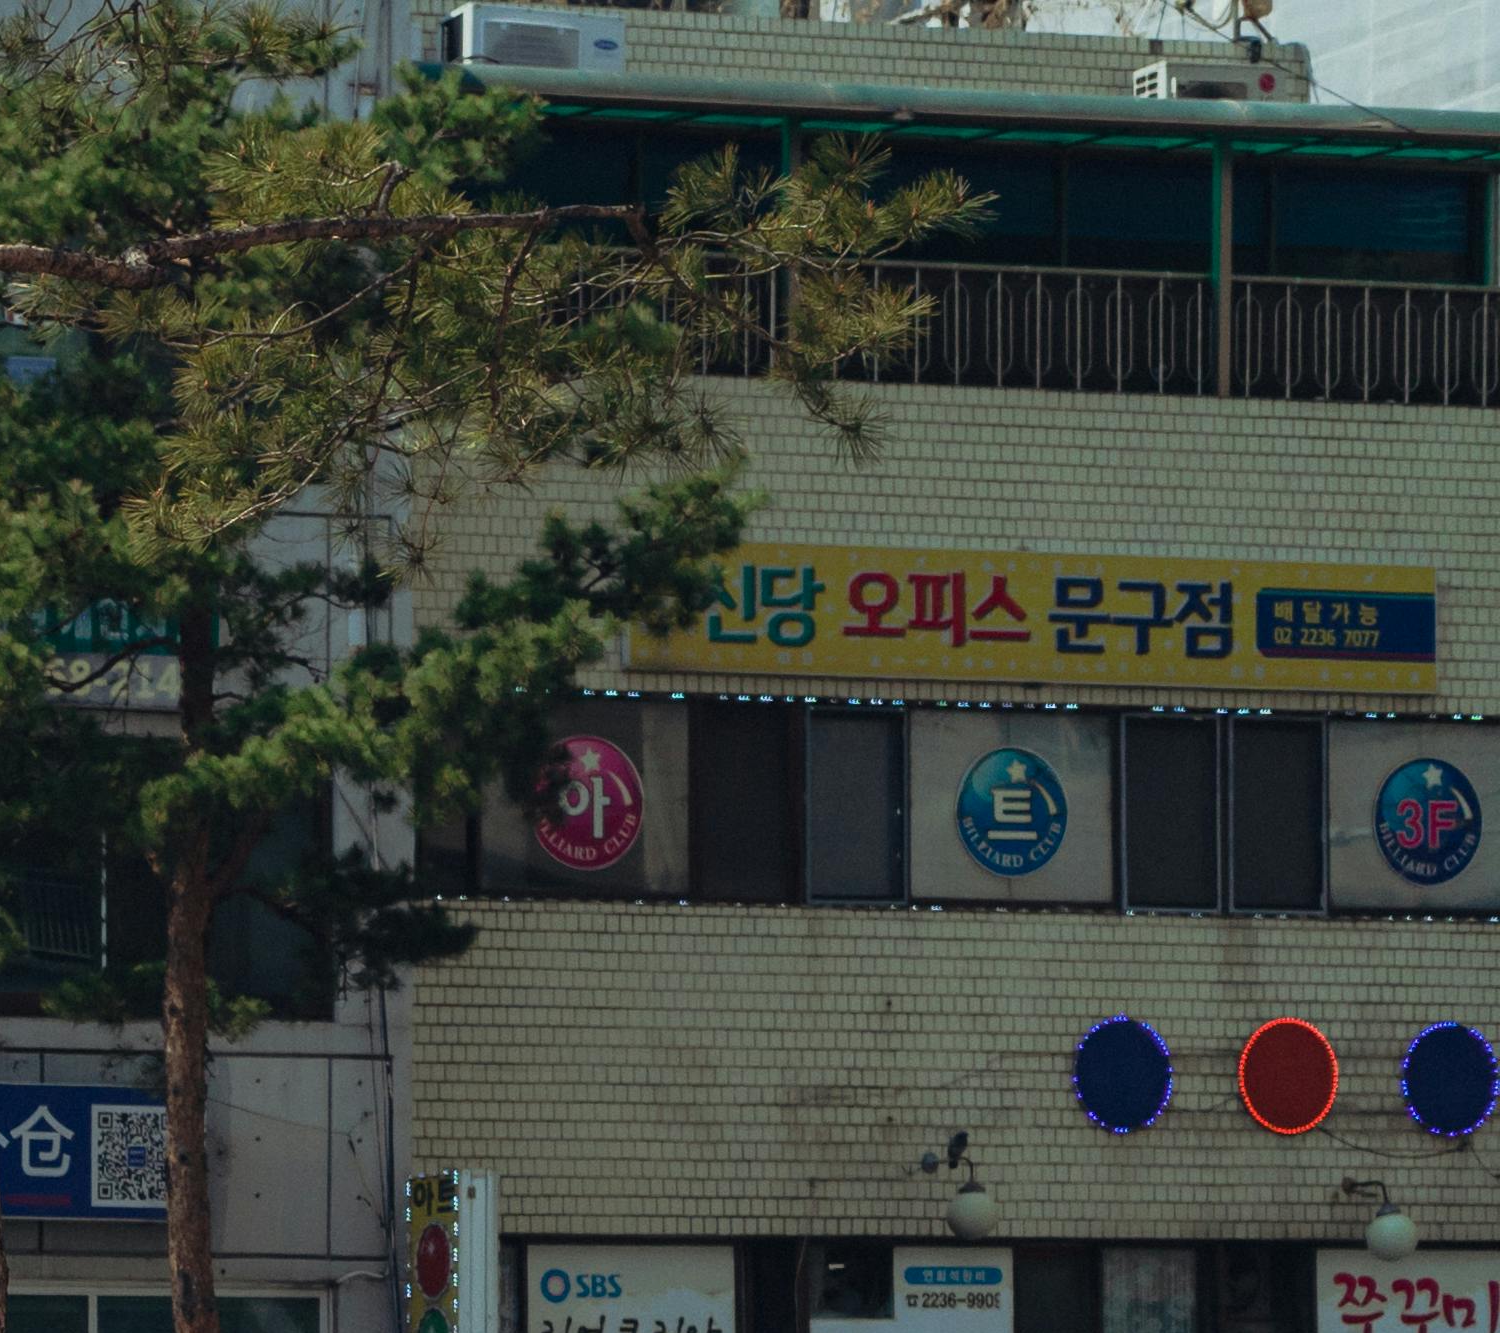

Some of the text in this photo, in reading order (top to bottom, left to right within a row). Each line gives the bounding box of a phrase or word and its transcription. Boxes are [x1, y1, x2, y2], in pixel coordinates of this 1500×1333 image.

[706, 564, 1232, 661] 신당 오피스 문구점
[1273, 627, 1380, 647] 02 2236 7077
[558, 776, 611, 838] 아
[1396, 797, 1458, 849] 3F
[604, 813, 637, 854] CLUB
[576, 1273, 622, 1299] SBS
